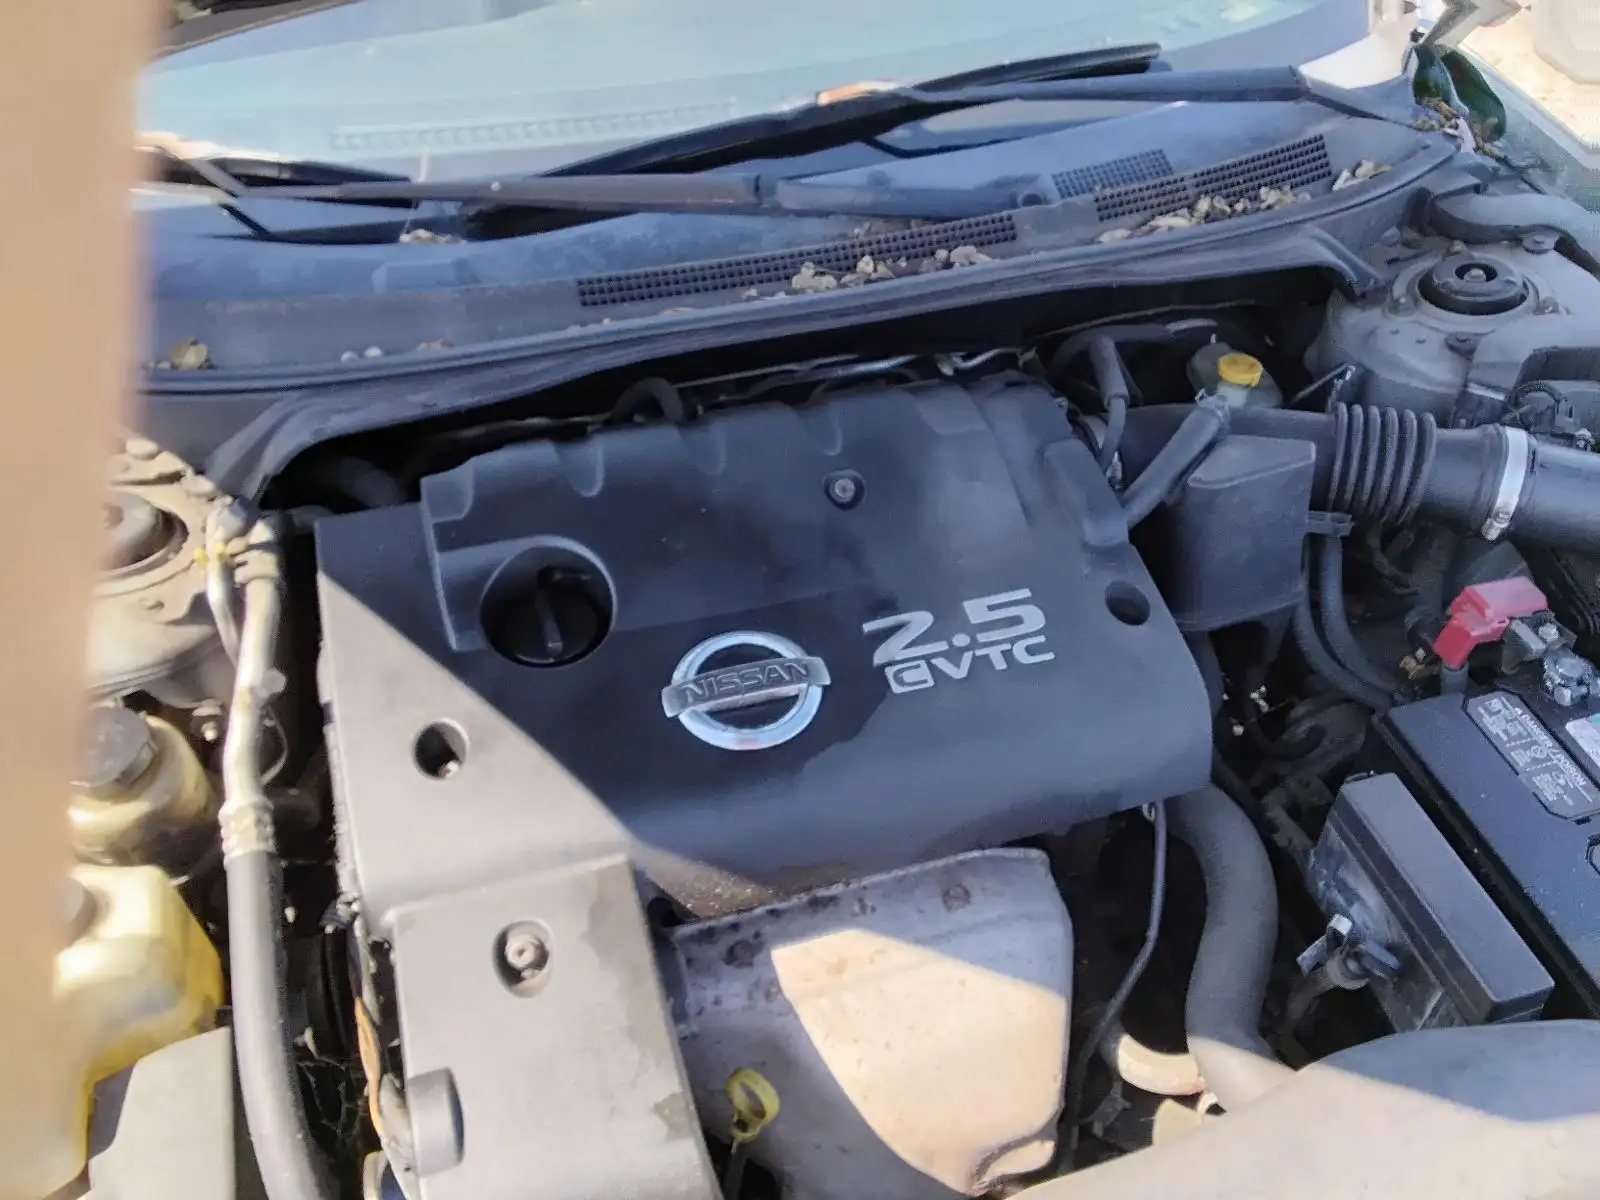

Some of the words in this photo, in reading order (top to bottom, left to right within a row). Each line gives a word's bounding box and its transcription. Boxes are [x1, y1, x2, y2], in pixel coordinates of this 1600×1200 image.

[862, 588, 1046, 668] 2.5
[682, 659, 809, 703] NISSAN
[1554, 754, 1587, 785] POISON
